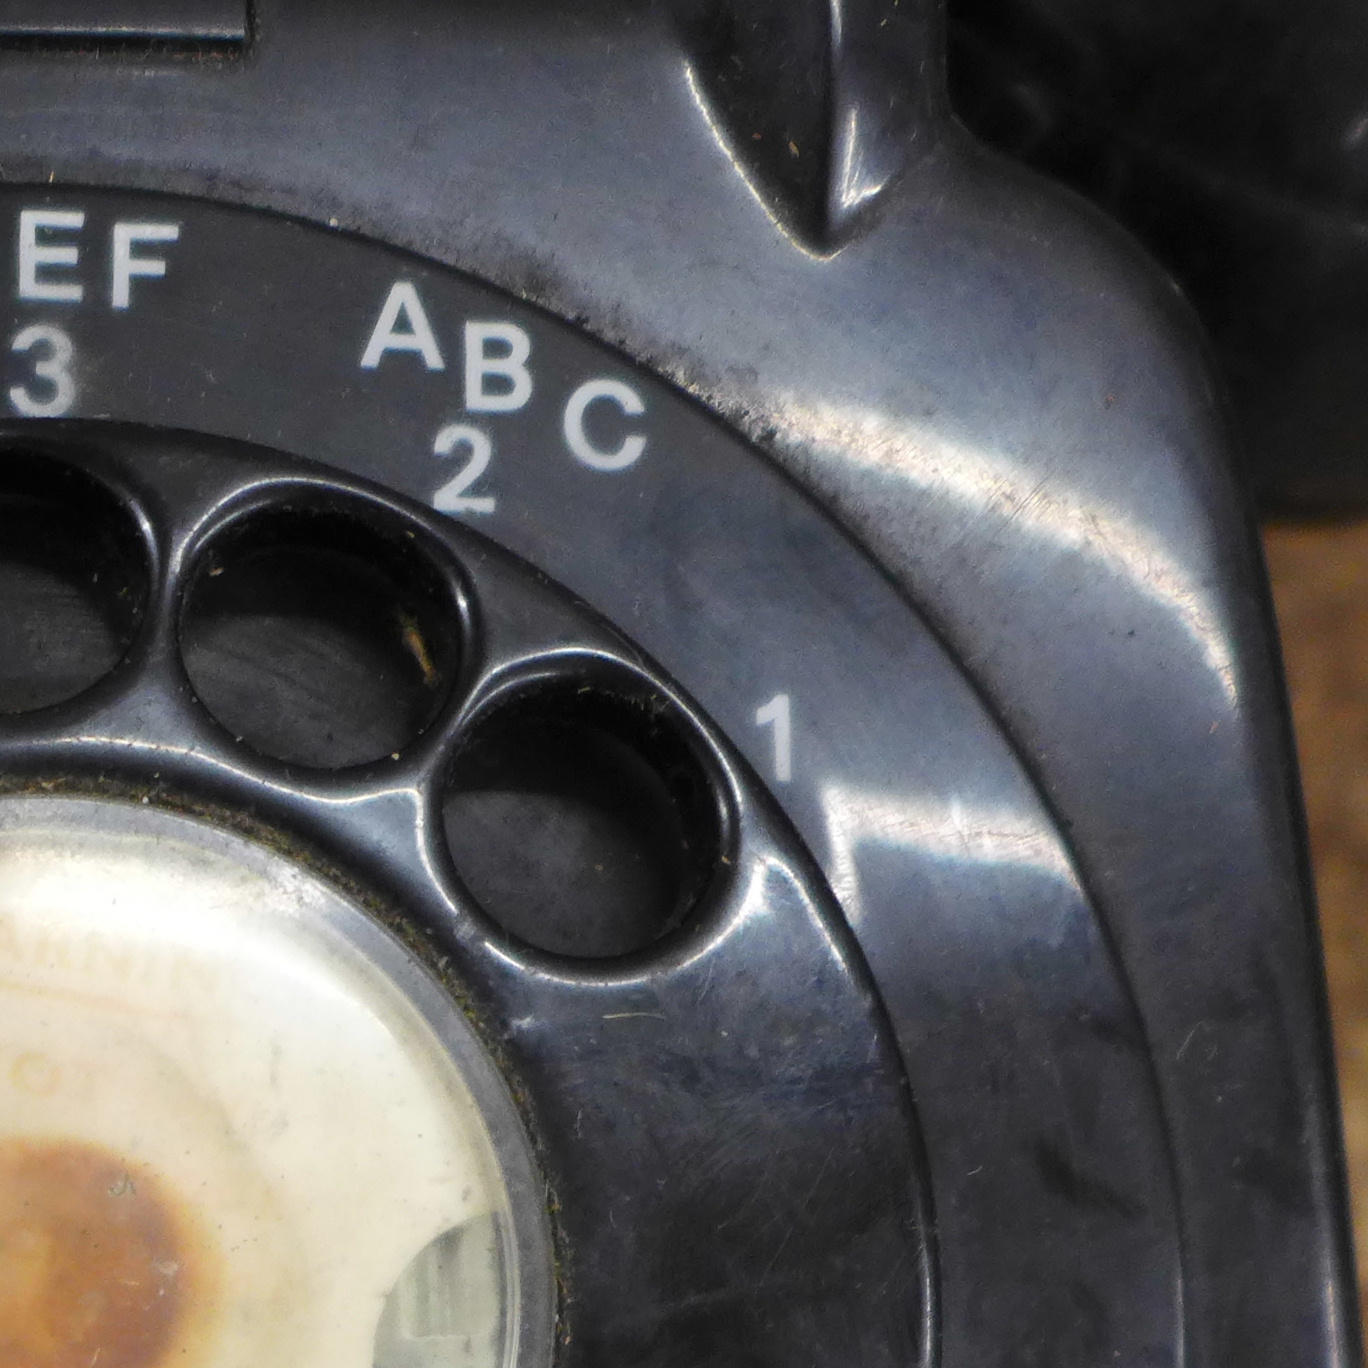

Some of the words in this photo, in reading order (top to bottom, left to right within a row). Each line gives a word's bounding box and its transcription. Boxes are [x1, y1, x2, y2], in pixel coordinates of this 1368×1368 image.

[9, 323, 77, 419] 3
[359, 280, 648, 472] ABC
[431, 422, 498, 516] 2
[755, 692, 796, 782] 1
